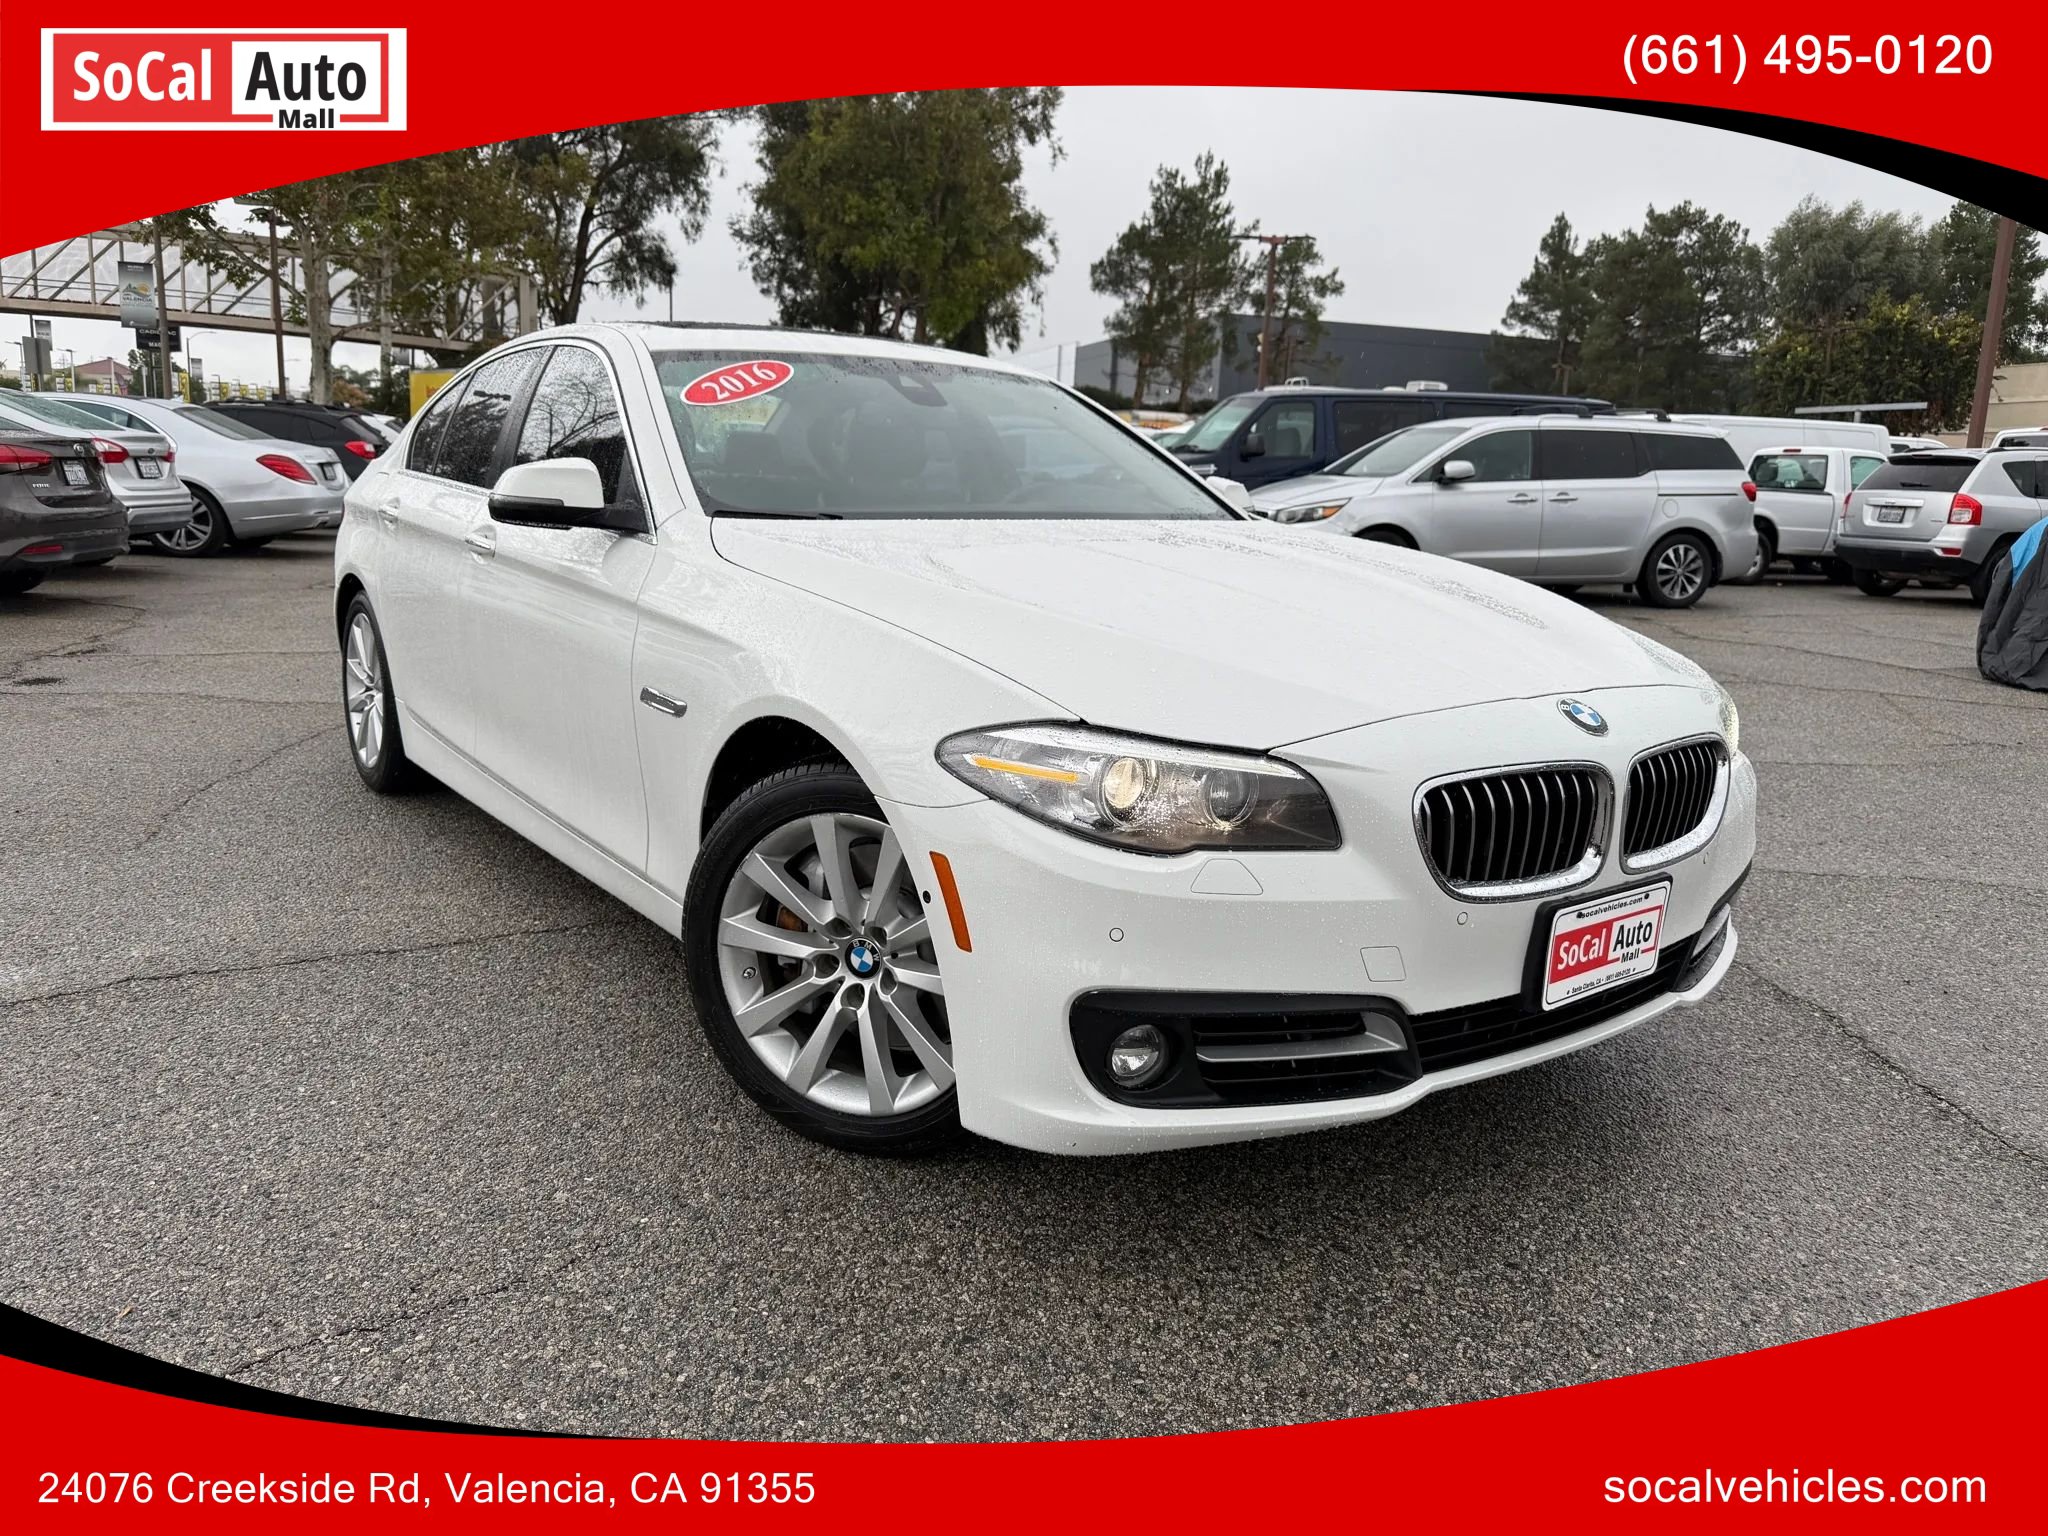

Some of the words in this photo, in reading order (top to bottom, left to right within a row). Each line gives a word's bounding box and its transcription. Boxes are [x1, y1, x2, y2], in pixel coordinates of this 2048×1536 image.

[701, 364, 777, 400] 2016
[1581, 897, 1643, 918] socalvehicles.com
[1557, 928, 1607, 970] SoCal
[1612, 920, 1653, 952] Auto
[1620, 948, 1640, 964] Mall
